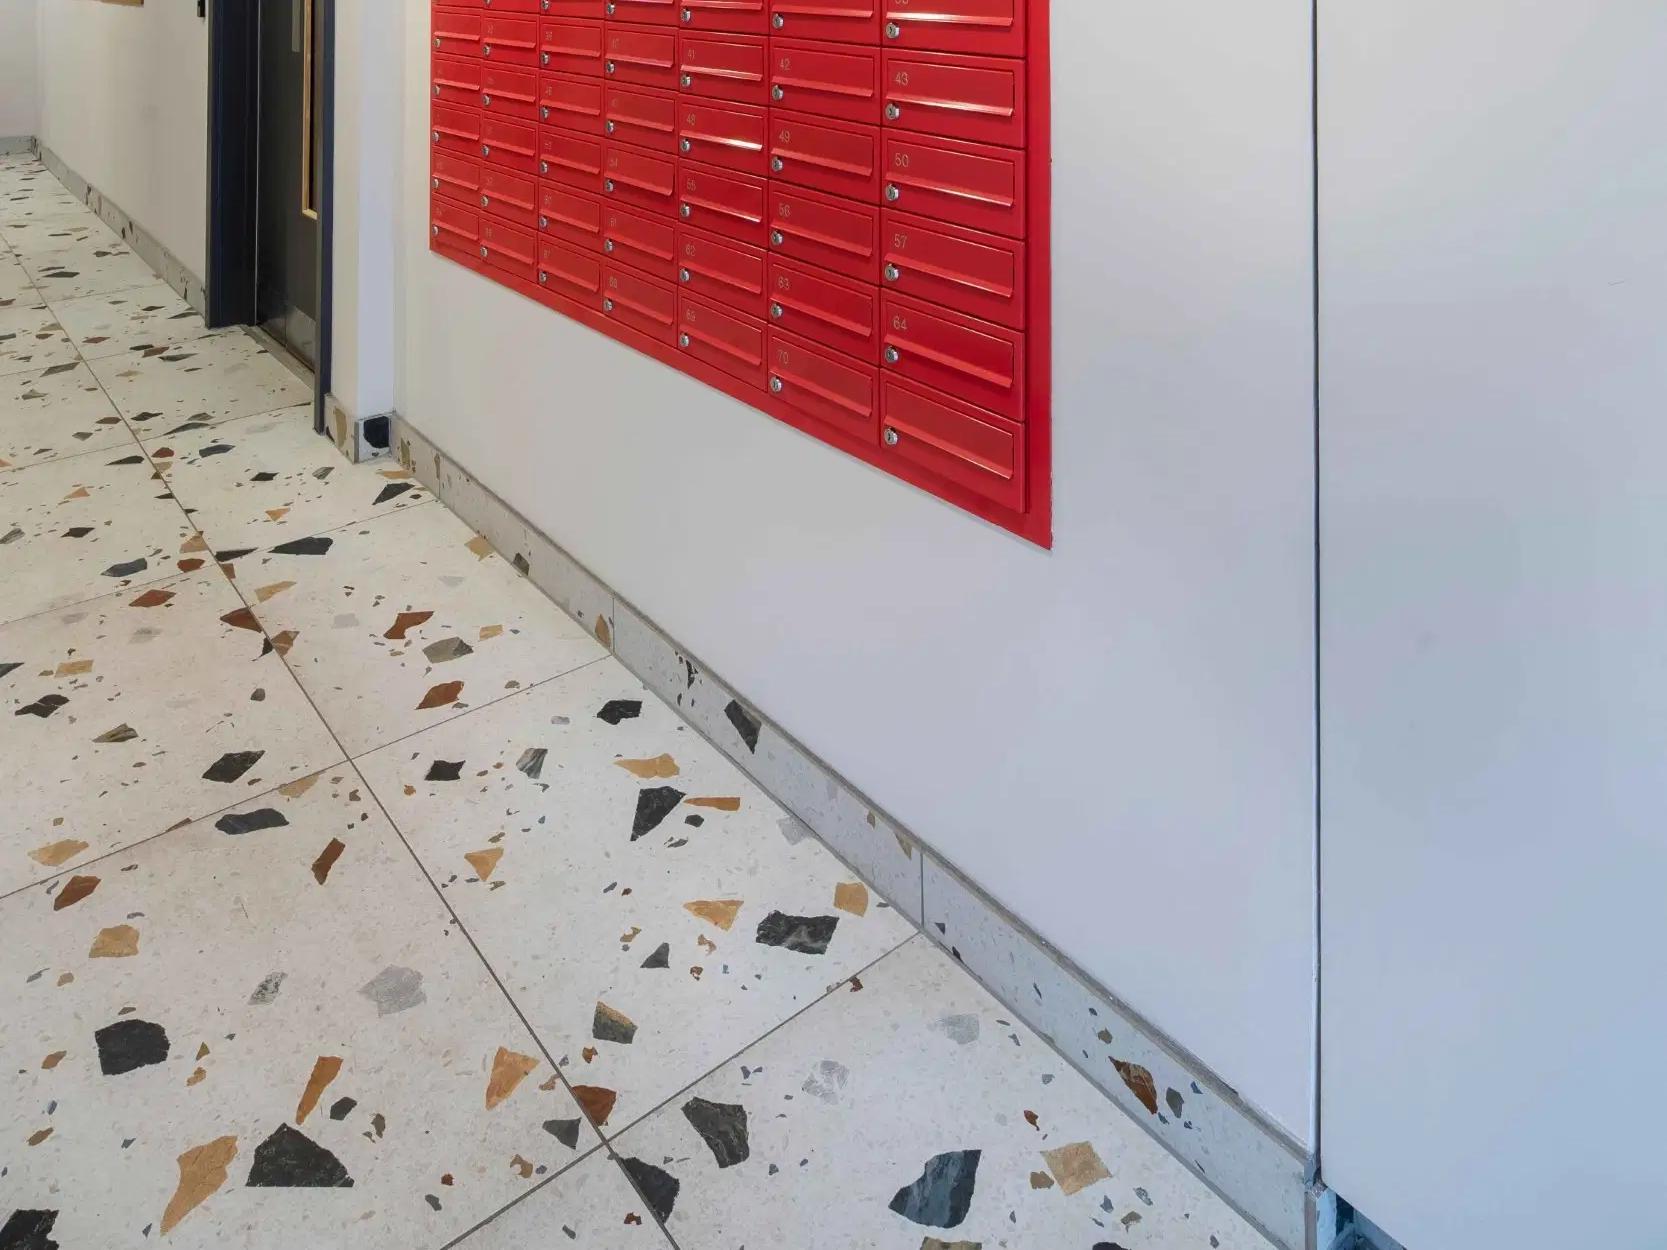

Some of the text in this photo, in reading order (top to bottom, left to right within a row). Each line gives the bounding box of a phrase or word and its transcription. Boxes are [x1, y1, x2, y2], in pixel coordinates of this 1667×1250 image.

[779, 57, 790, 71] 42
[893, 71, 909, 86] 43
[779, 129, 790, 143] 49
[895, 152, 909, 168] 50
[779, 202, 791, 217] 56
[894, 233, 908, 249] 57
[893, 314, 909, 330] 64
[777, 349, 789, 364] 70
